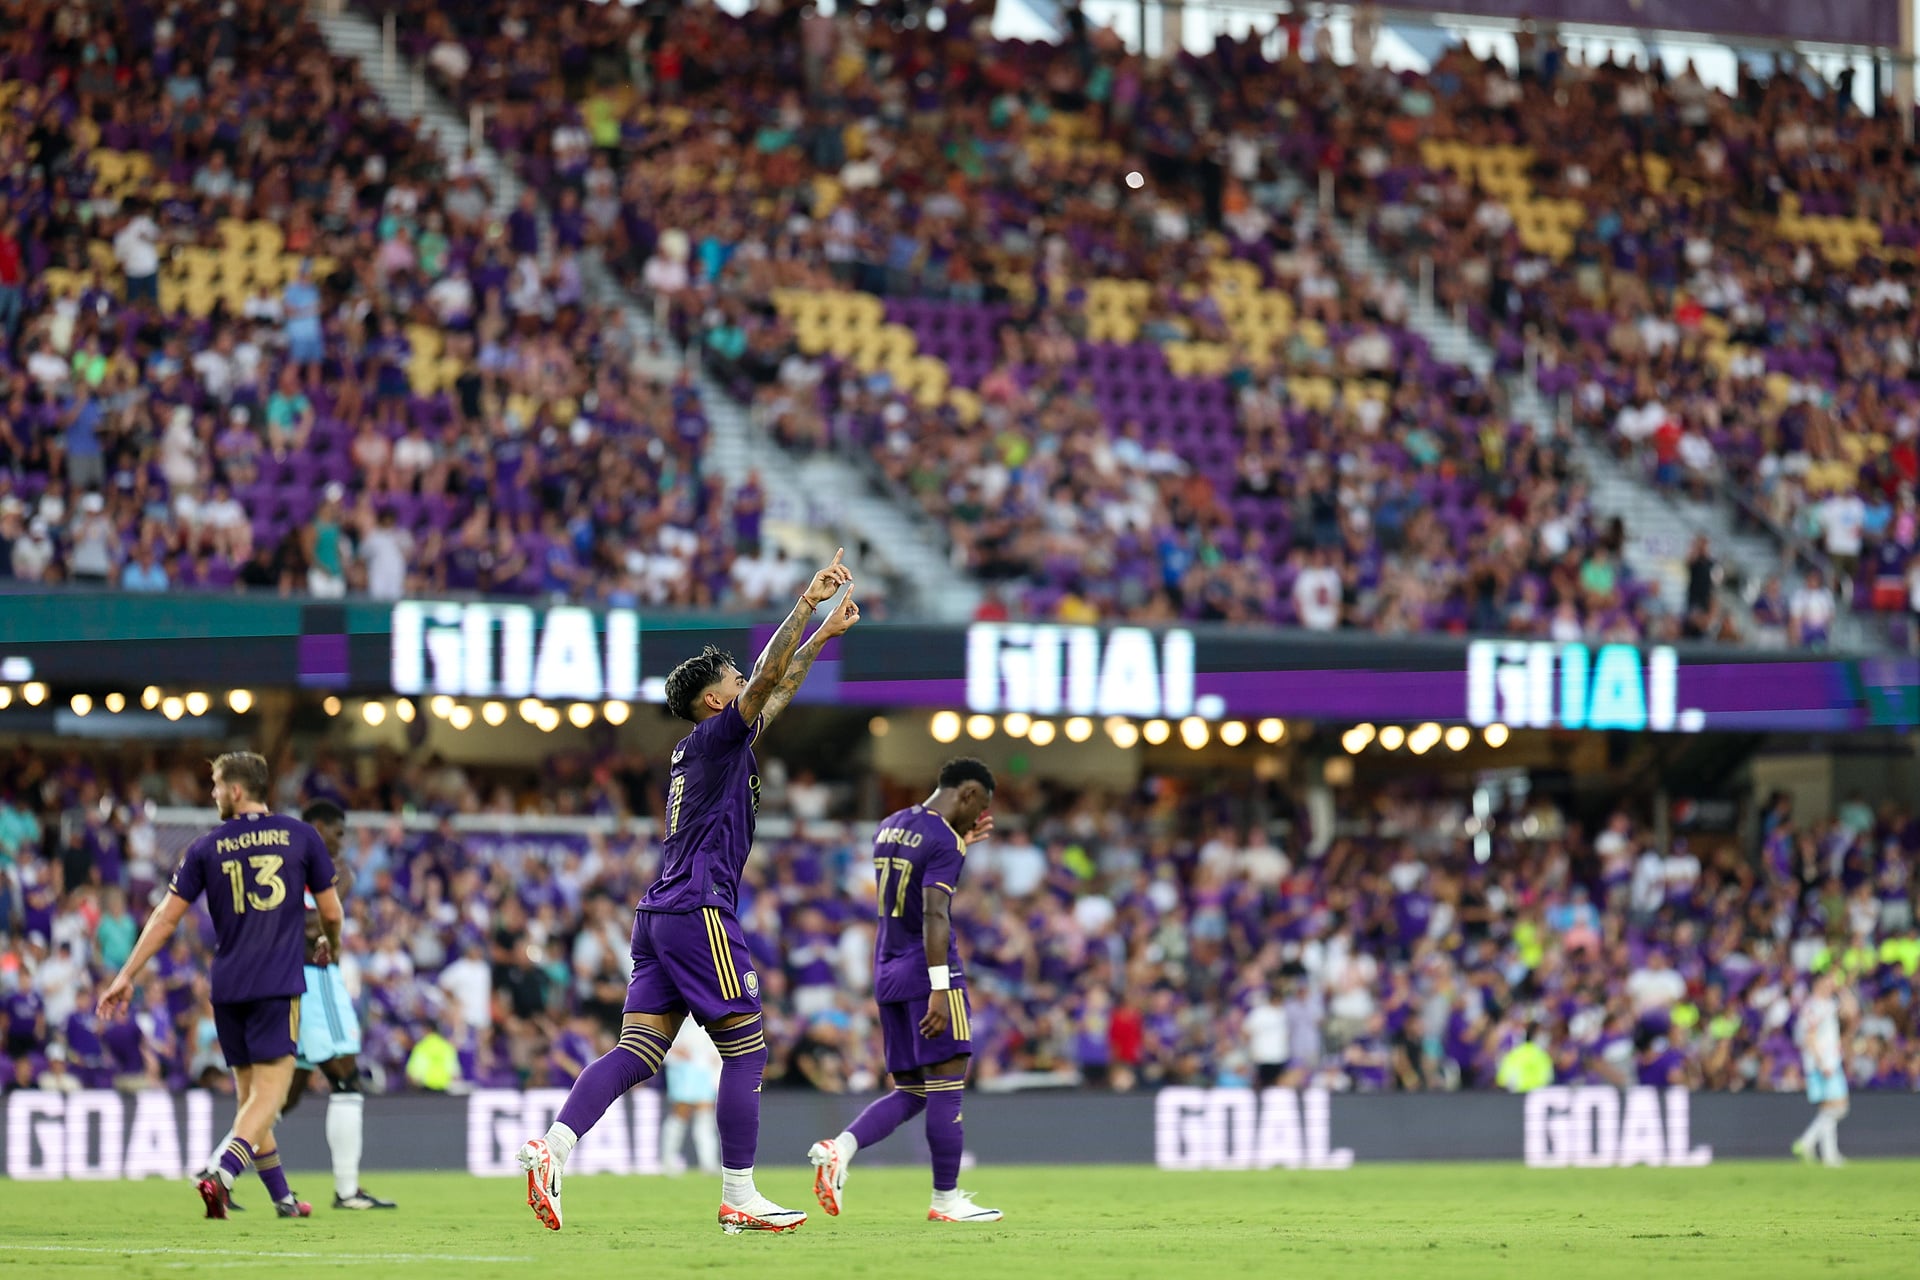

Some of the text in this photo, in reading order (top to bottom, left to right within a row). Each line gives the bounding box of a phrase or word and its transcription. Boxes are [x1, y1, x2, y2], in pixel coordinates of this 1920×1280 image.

[216, 829, 291, 854] McGUIRE
[221, 854, 286, 914] 13
[873, 857, 913, 917] 77
[1155, 1085, 1355, 1170] GOAL
[1524, 1084, 1713, 1168] GOAL
